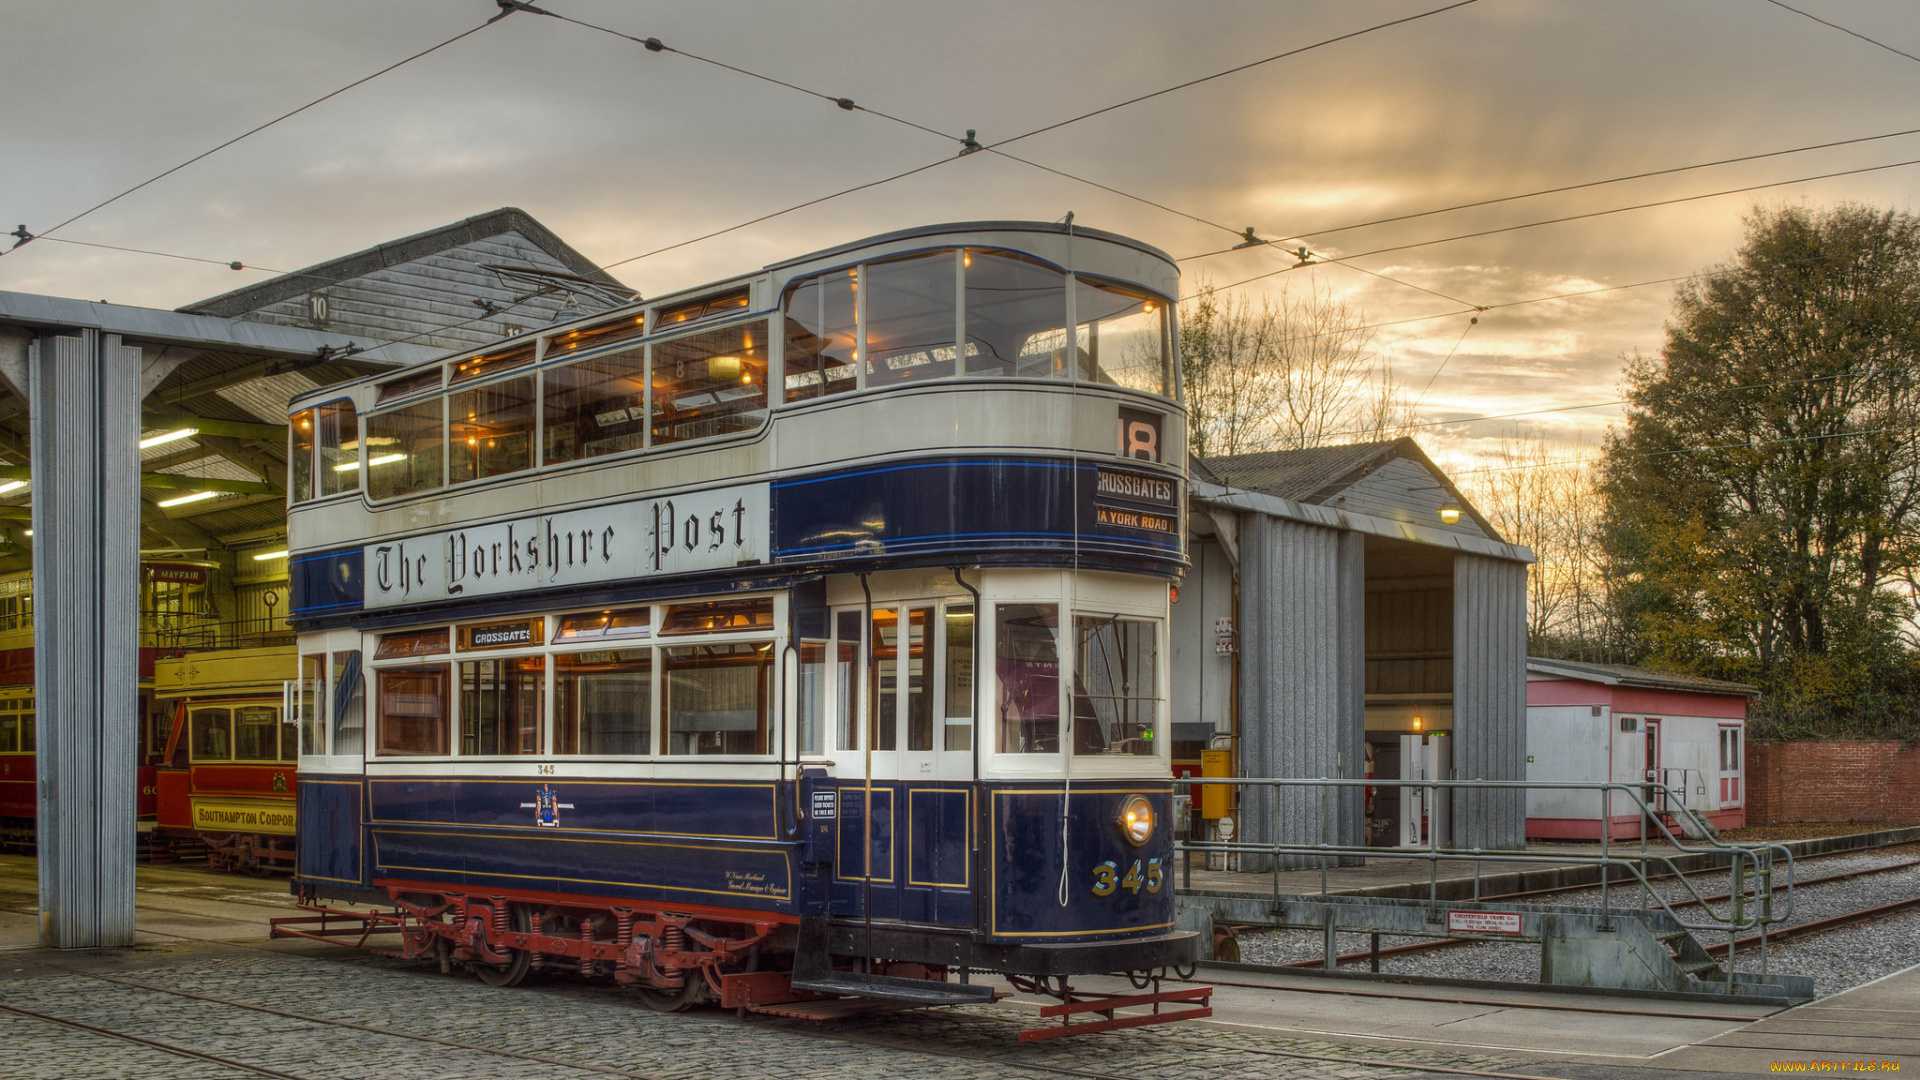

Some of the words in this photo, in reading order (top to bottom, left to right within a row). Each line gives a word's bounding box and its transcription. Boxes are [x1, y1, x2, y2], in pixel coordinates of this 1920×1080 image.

[311, 296, 327, 320] 10
[1109, 511, 1138, 527] YORK
[1141, 516, 1168, 530] ROAD
[376, 542, 427, 601] The
[447, 516, 615, 594] Yorkshire
[649, 497, 746, 572] Post
[161, 571, 199, 580] MAYFAIR
[475, 630, 531, 644] CROSSGATES
[537, 764, 555, 775] 345
[199, 808, 257, 825] SOUTHAMPTON
[259, 811, 297, 827] CORPOR
[1091, 858, 1164, 897] 345
